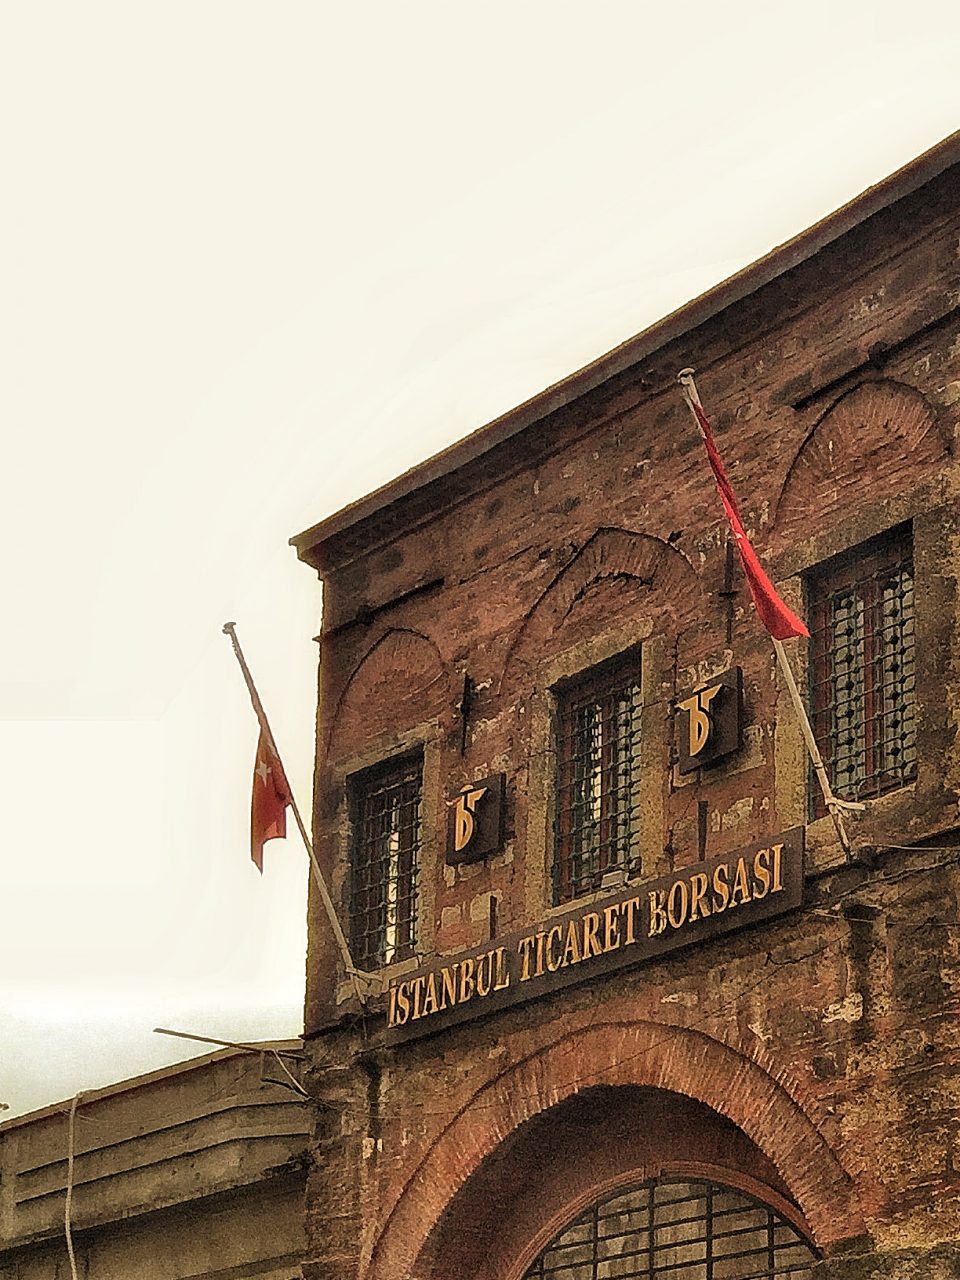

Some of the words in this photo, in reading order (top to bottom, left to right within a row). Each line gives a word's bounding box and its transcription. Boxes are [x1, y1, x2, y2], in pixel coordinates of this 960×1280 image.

[388, 946, 510, 1028] İSTANBUL
[518, 899, 641, 982] TİCARET
[647, 843, 786, 938] BORSASI
